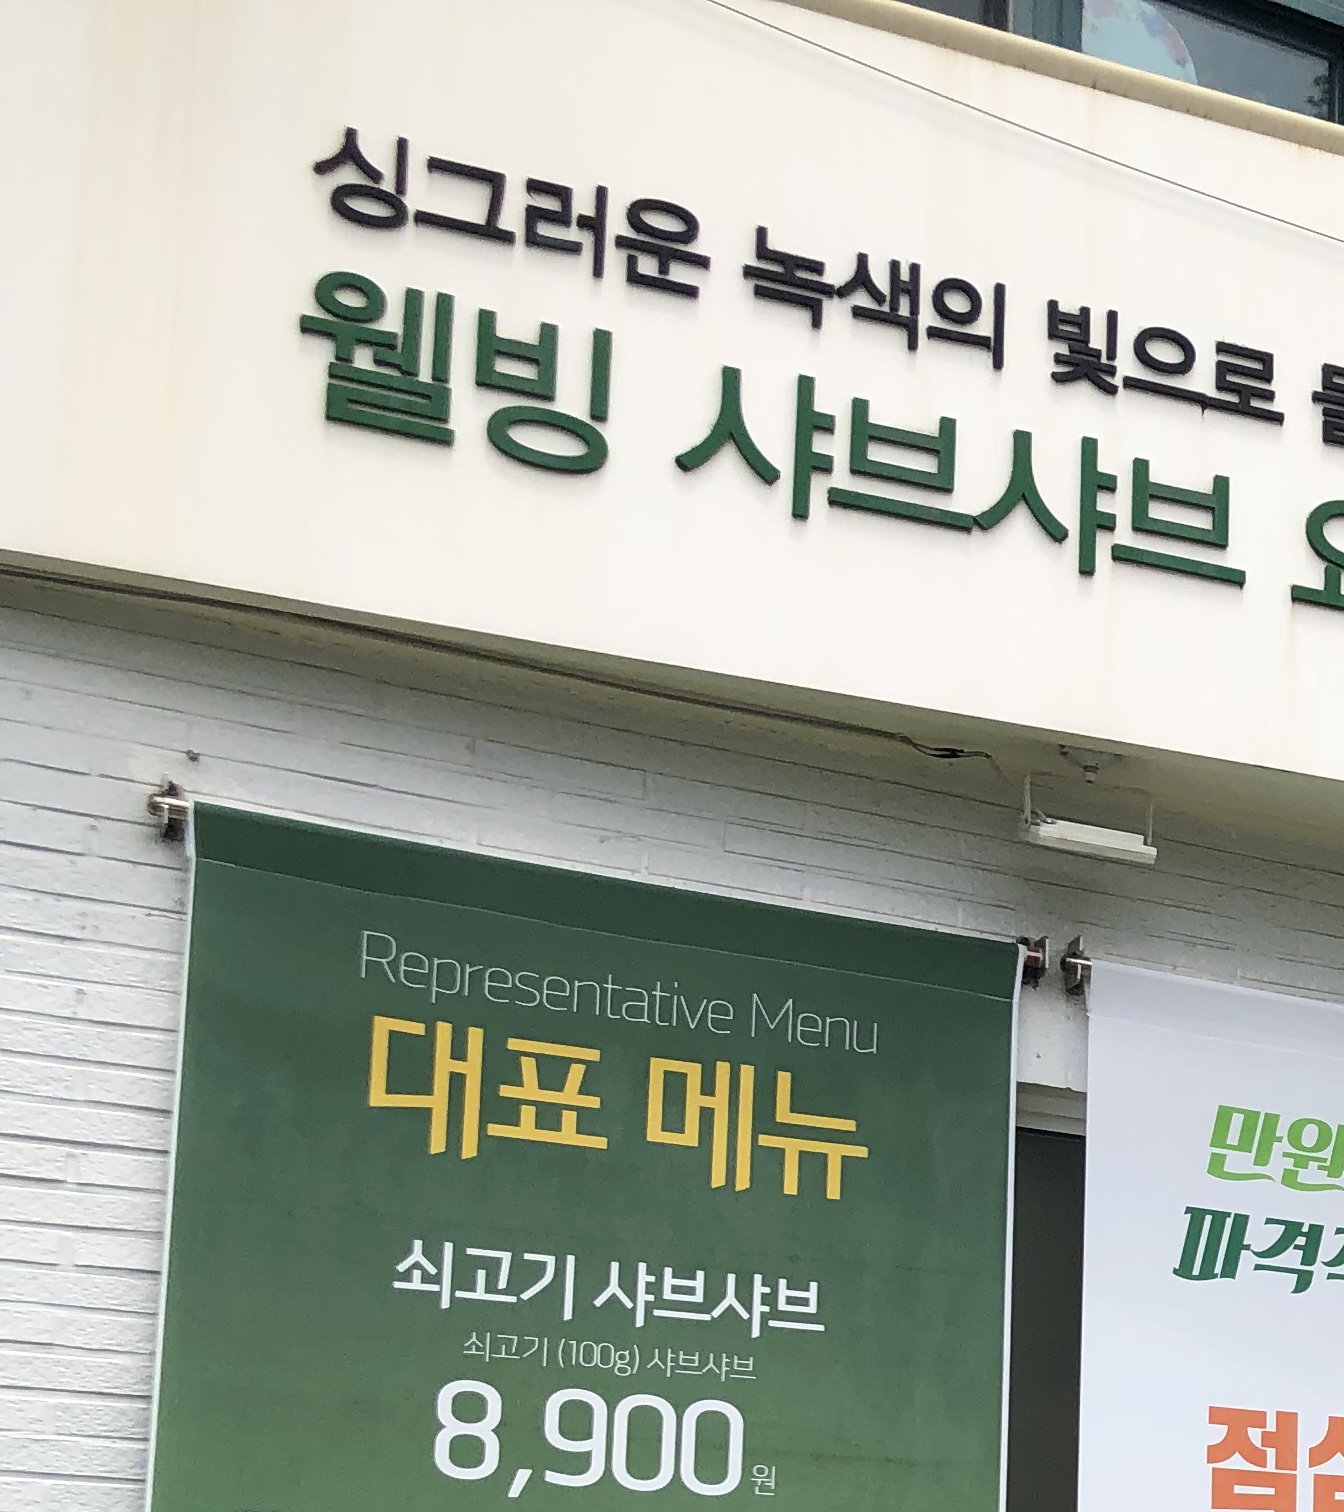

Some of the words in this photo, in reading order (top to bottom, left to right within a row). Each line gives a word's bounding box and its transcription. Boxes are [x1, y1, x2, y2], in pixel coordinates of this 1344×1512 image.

[313, 127, 711, 299] 싱그러운
[742, 225, 1006, 370] 녹색의
[1047, 299, 1285, 426] 빛으로
[299, 271, 613, 475] 웰빙
[675, 366, 1247, 576] 샤브샤브
[358, 929, 737, 1034] Representative
[749, 993, 880, 1055] Menu
[368, 1015, 609, 1160] 대표
[646, 1056, 869, 1201] 메뉴
[392, 1238, 576, 1321] 쇠고기
[592, 1261, 826, 1339] 샤브샤브
[646, 1345, 757, 1380] 샤브샤브
[432, 1378, 745, 1499] 8,900
[750, 1463, 777, 1497] 원
